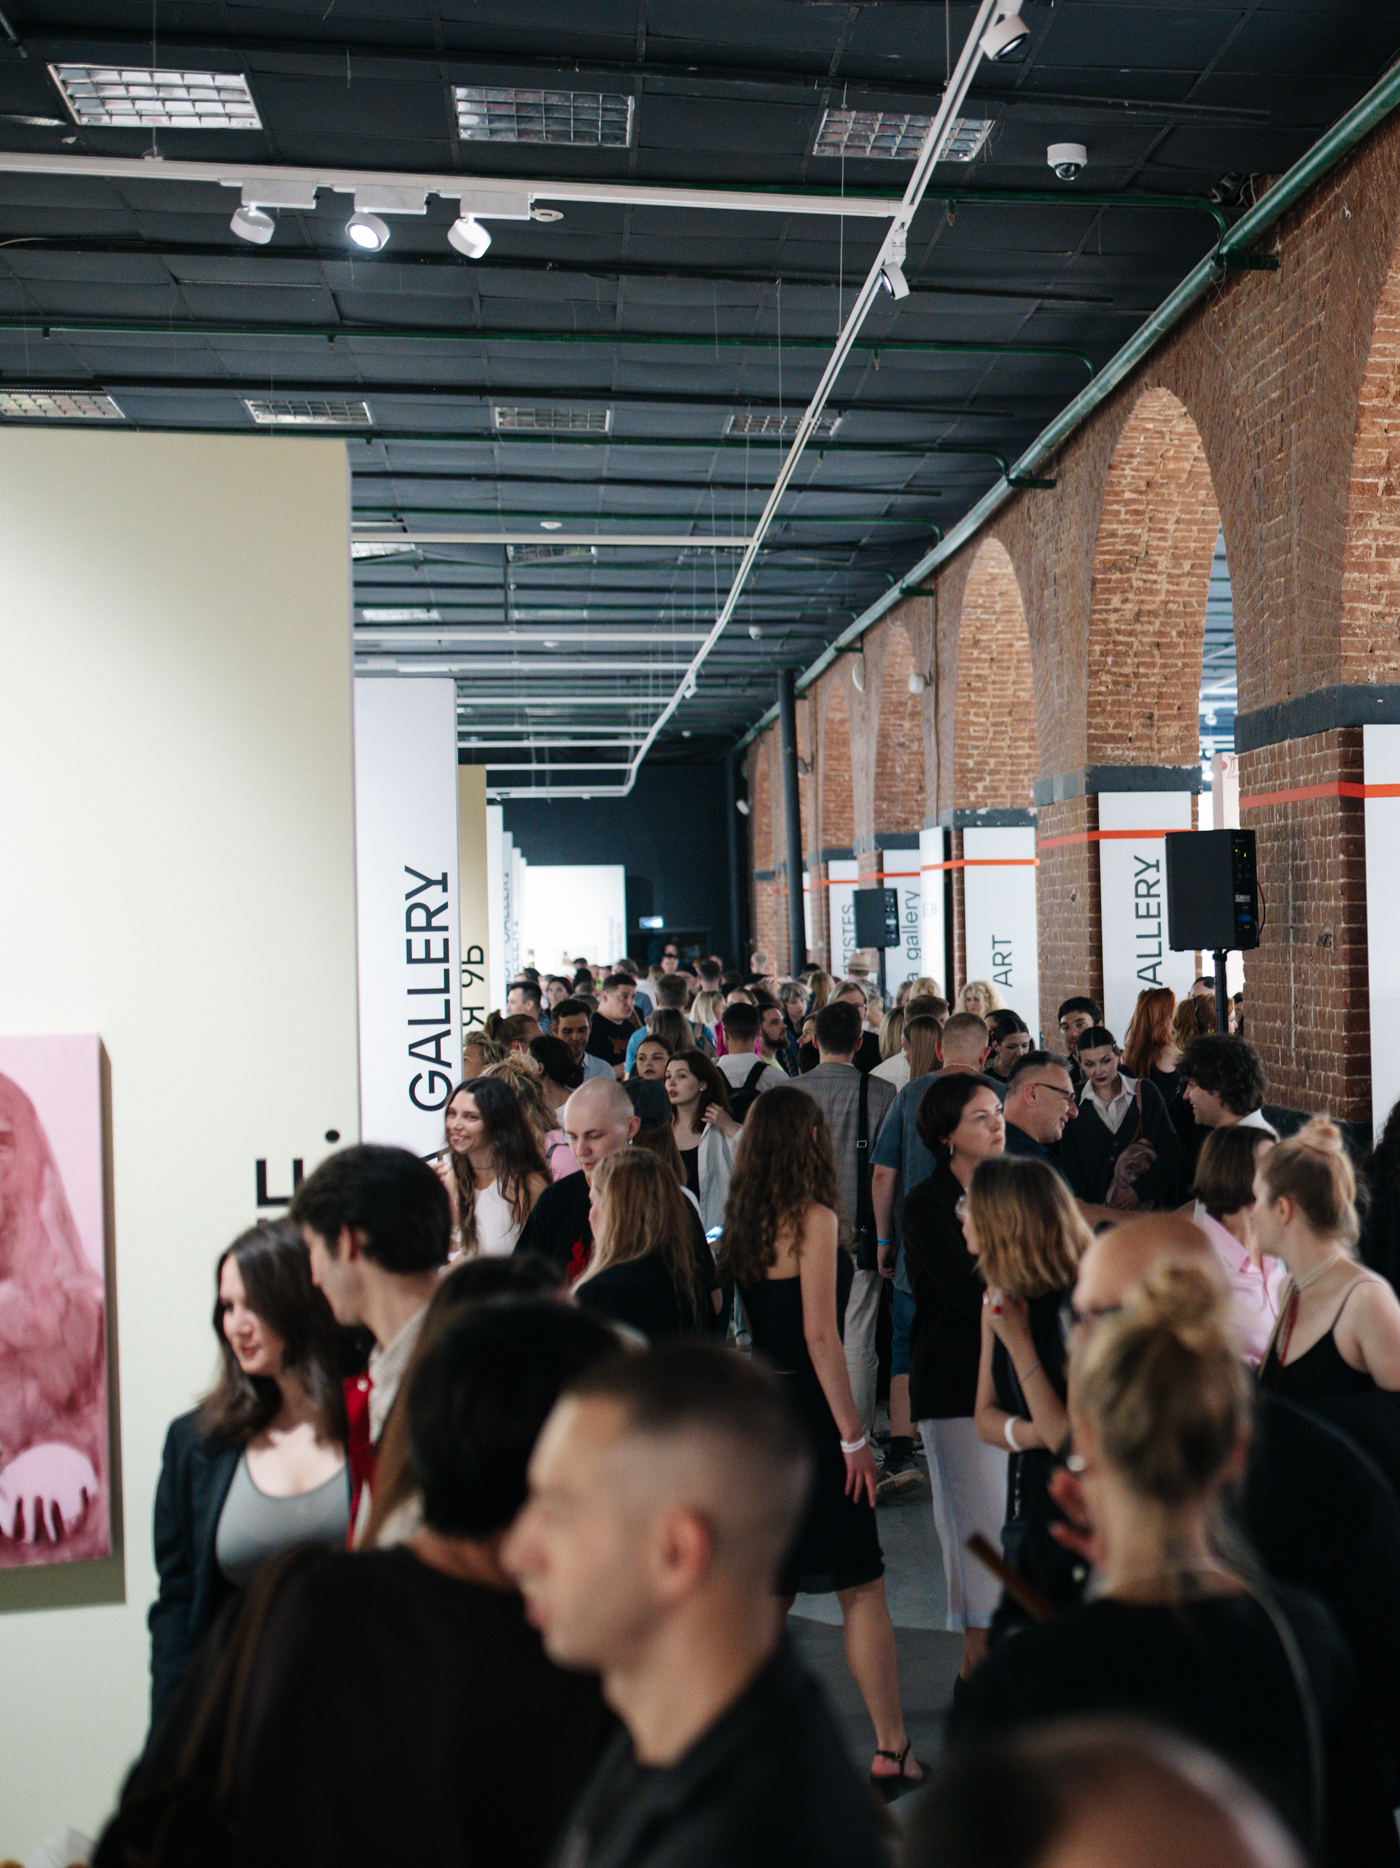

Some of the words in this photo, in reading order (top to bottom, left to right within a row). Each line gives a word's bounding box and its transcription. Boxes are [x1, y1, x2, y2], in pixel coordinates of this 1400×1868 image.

[900, 889, 921, 960] gallery
[992, 934, 1013, 988] ART
[1134, 854, 1163, 988] ALLERY
[404, 865, 453, 1112] GALLERY
